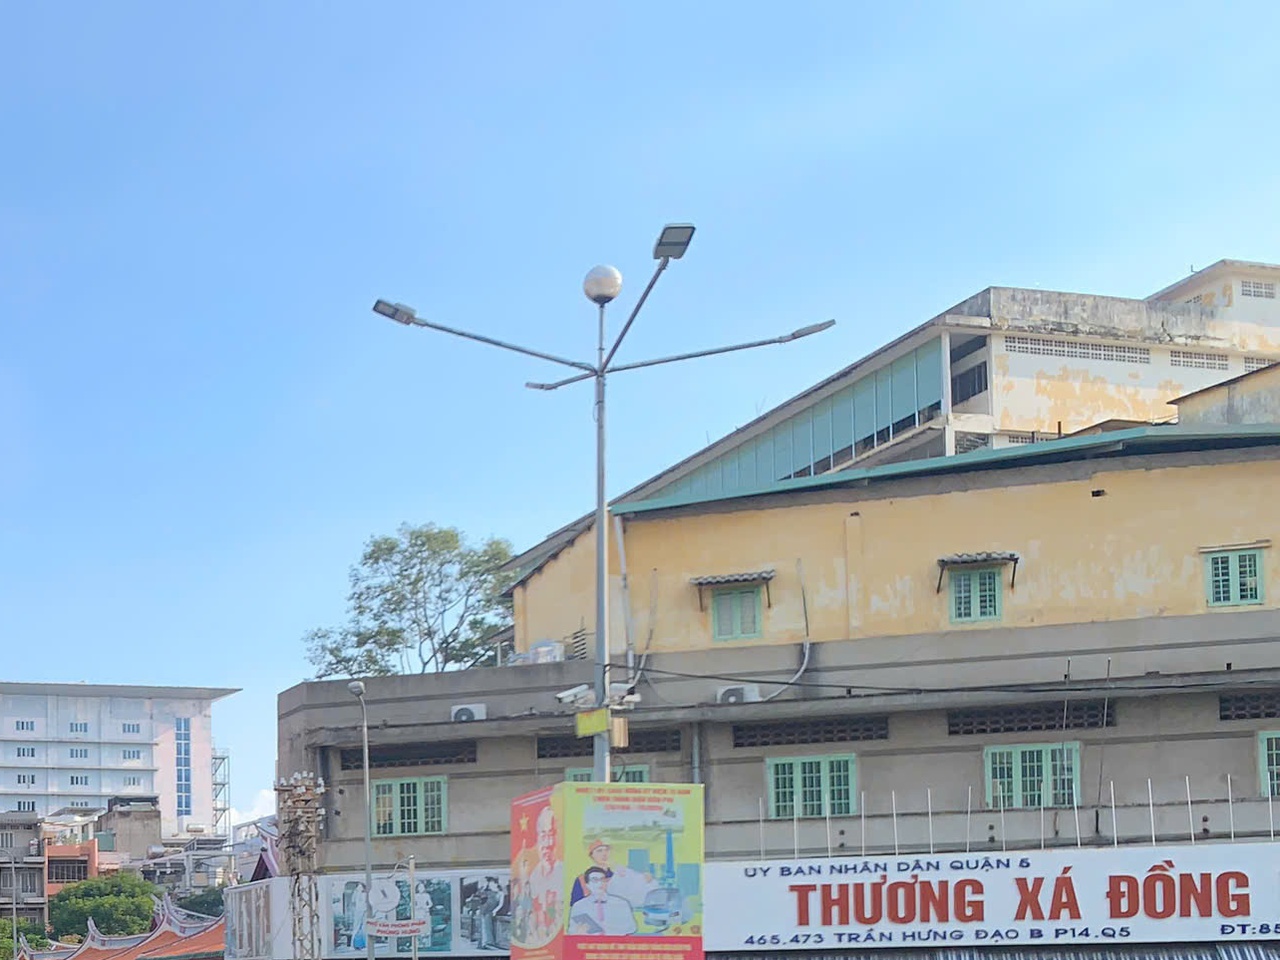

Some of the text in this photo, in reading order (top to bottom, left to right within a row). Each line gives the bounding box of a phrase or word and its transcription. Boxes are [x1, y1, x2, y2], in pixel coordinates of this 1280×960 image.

[779, 865, 822, 878] BAN
[829, 860, 888, 875] NHÂN
[896, 859, 941, 873] DÂN
[949, 857, 1011, 873] QUẬN
[1019, 857, 1031, 869] 5
[788, 859, 1251, 927] THƯƠNG XÁ ĐỒNG
[743, 933, 825, 946] 465.473
[833, 927, 893, 943] TRẦN
[902, 928, 965, 942] HƯNG
[975, 928, 1019, 944] ĐẠO
[1029, 928, 1044, 939] B
